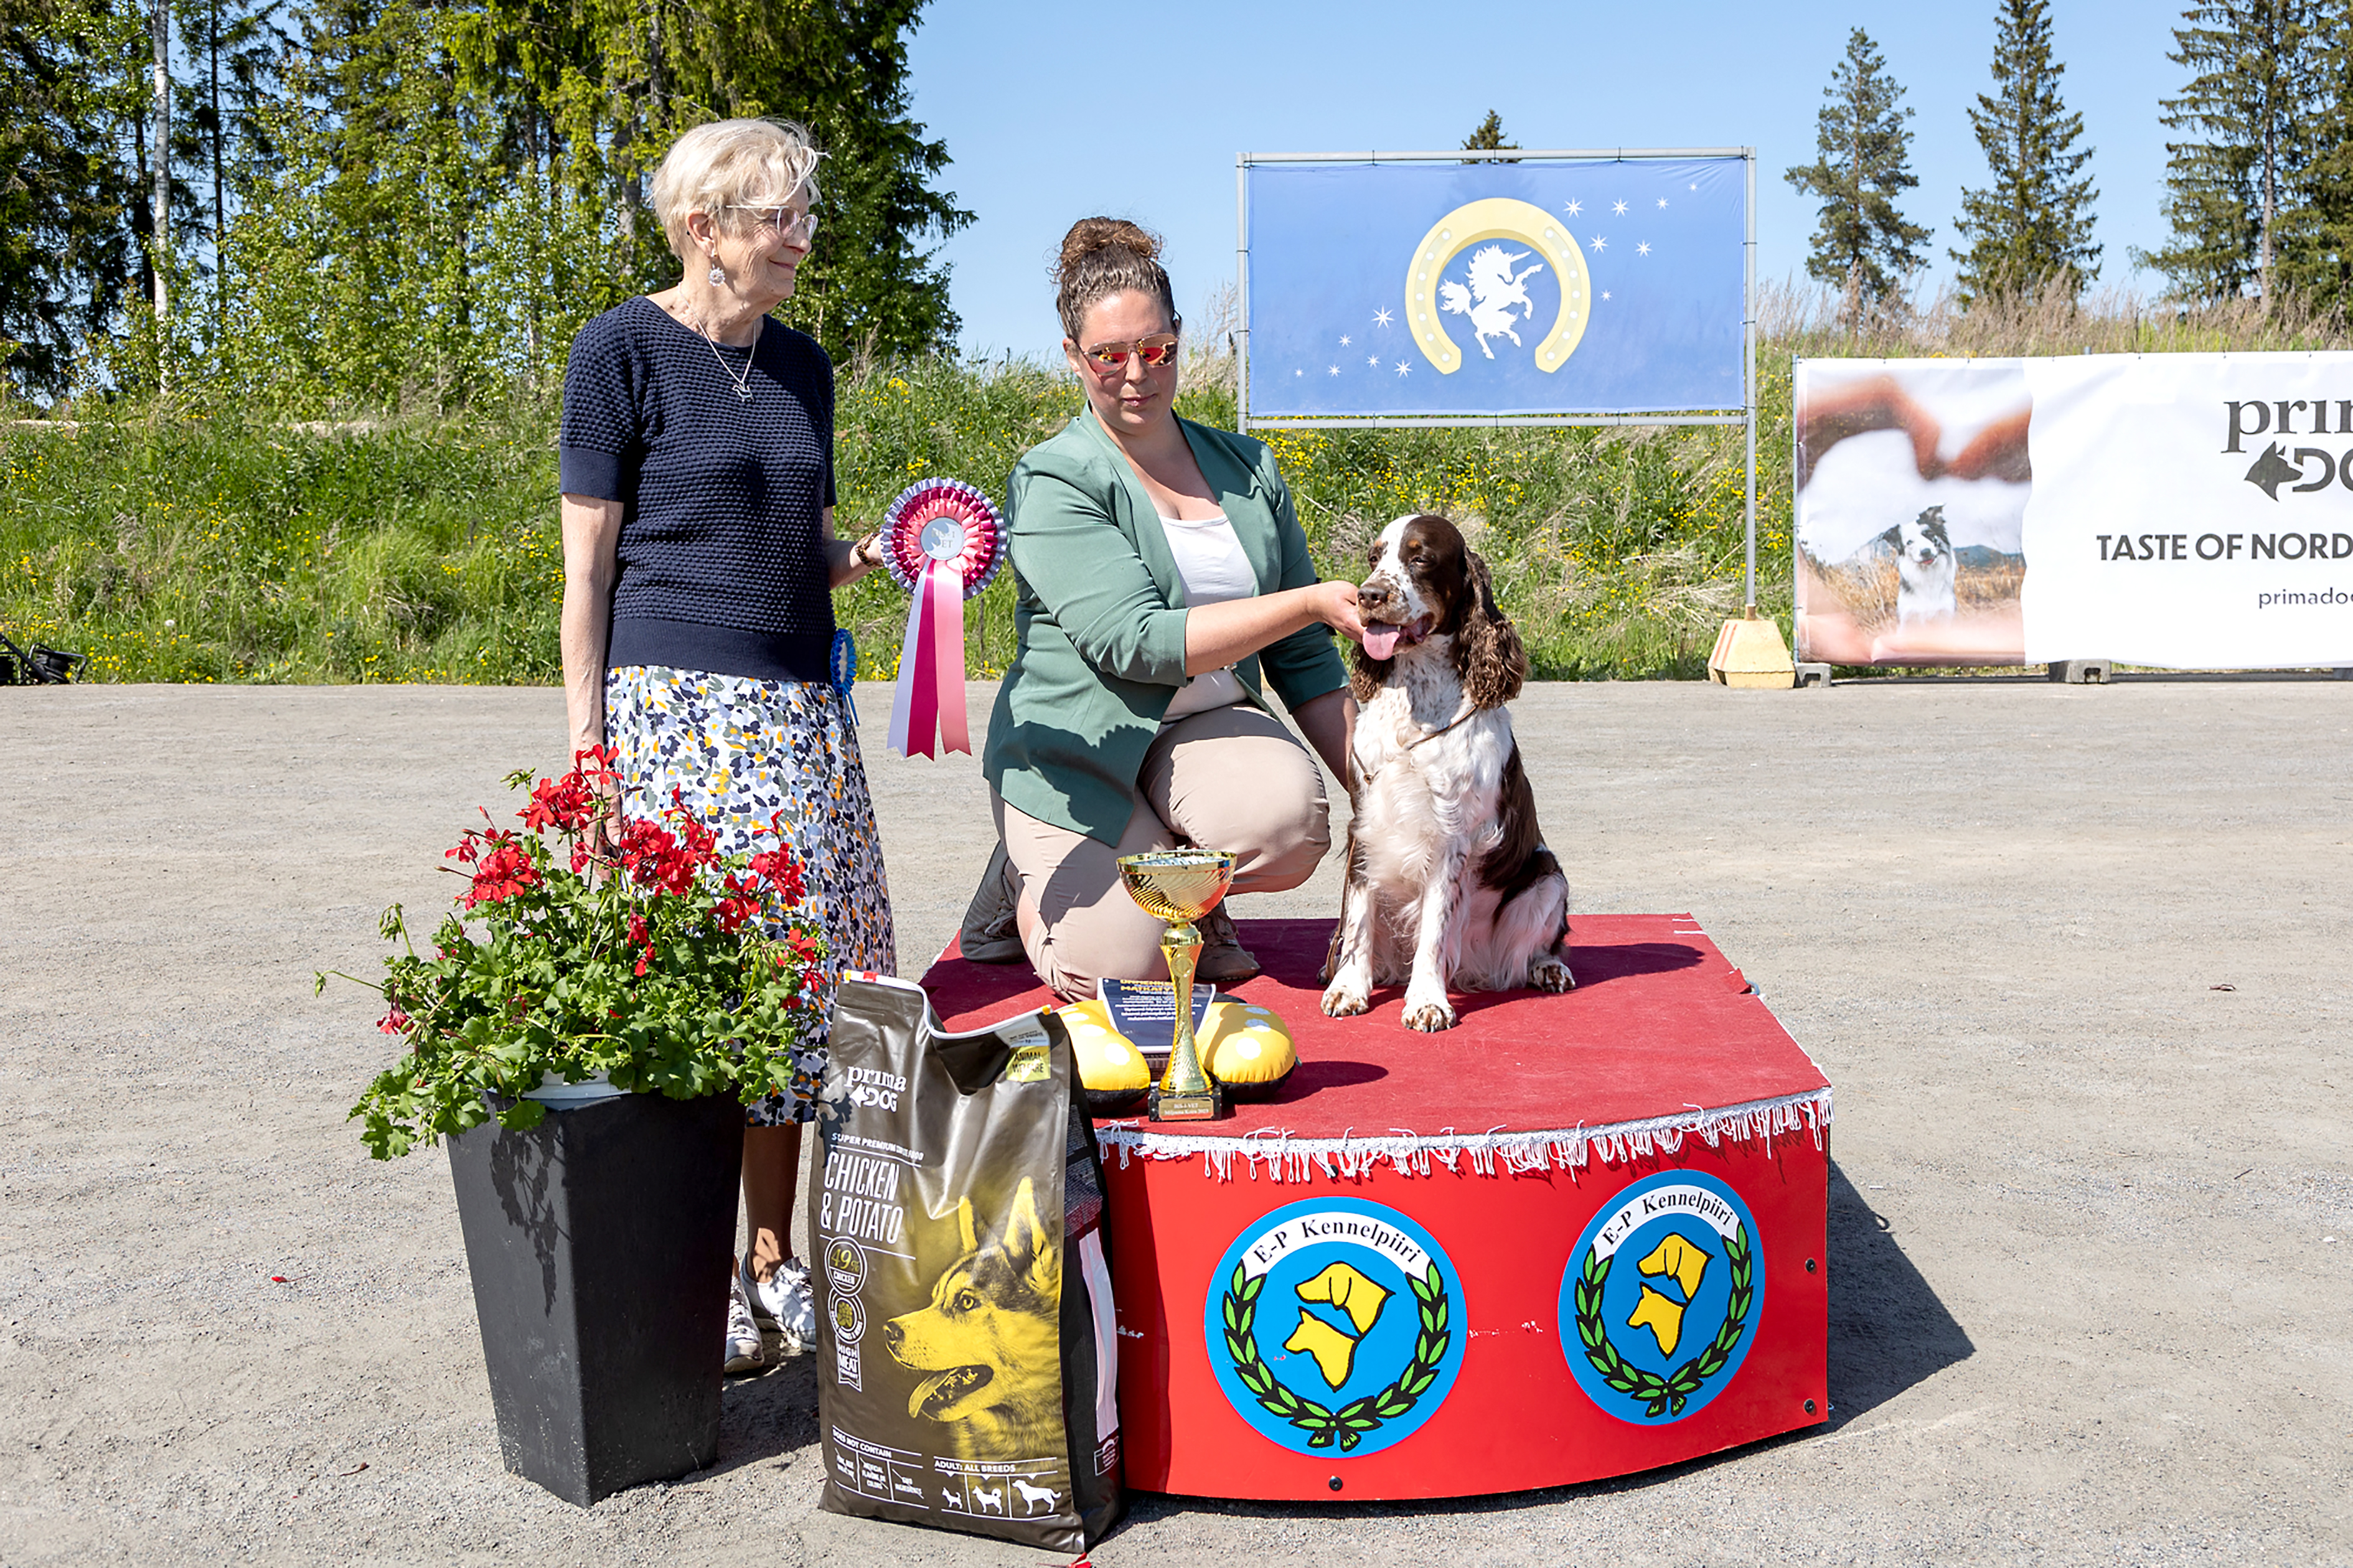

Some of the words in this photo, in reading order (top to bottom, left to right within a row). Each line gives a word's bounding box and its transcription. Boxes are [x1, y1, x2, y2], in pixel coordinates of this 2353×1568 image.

[2097, 534, 2187, 560] TASTE
[2196, 533, 2243, 560] OF
[2252, 533, 2353, 560] NORD
[2259, 587, 2353, 609] primado
[843, 1066, 907, 1092] prima
[1012, 1063, 1043, 1073] WEFARE
[863, 1087, 898, 1112] DOG
[832, 1132, 862, 1145] SUPER
[862, 1138, 896, 1152] PREMIUM
[824, 1152, 899, 1201] CHICKEN
[820, 1191, 832, 1230] &
[835, 1196, 904, 1244] POTATO
[1602, 1210, 1632, 1246] E-P
[1642, 1191, 1733, 1226] Kennelpiiri
[1253, 1231, 1287, 1264] E-P
[1301, 1219, 1421, 1263] Kennelpiiri
[838, 1343, 857, 1358] HIGH
[847, 1438, 860, 1449] NOT
[860, 1442, 892, 1458] CONTAIN
[934, 1460, 963, 1471] ADULT:
[964, 1463, 980, 1472] ALL
[981, 1464, 1016, 1473] BREEDS
